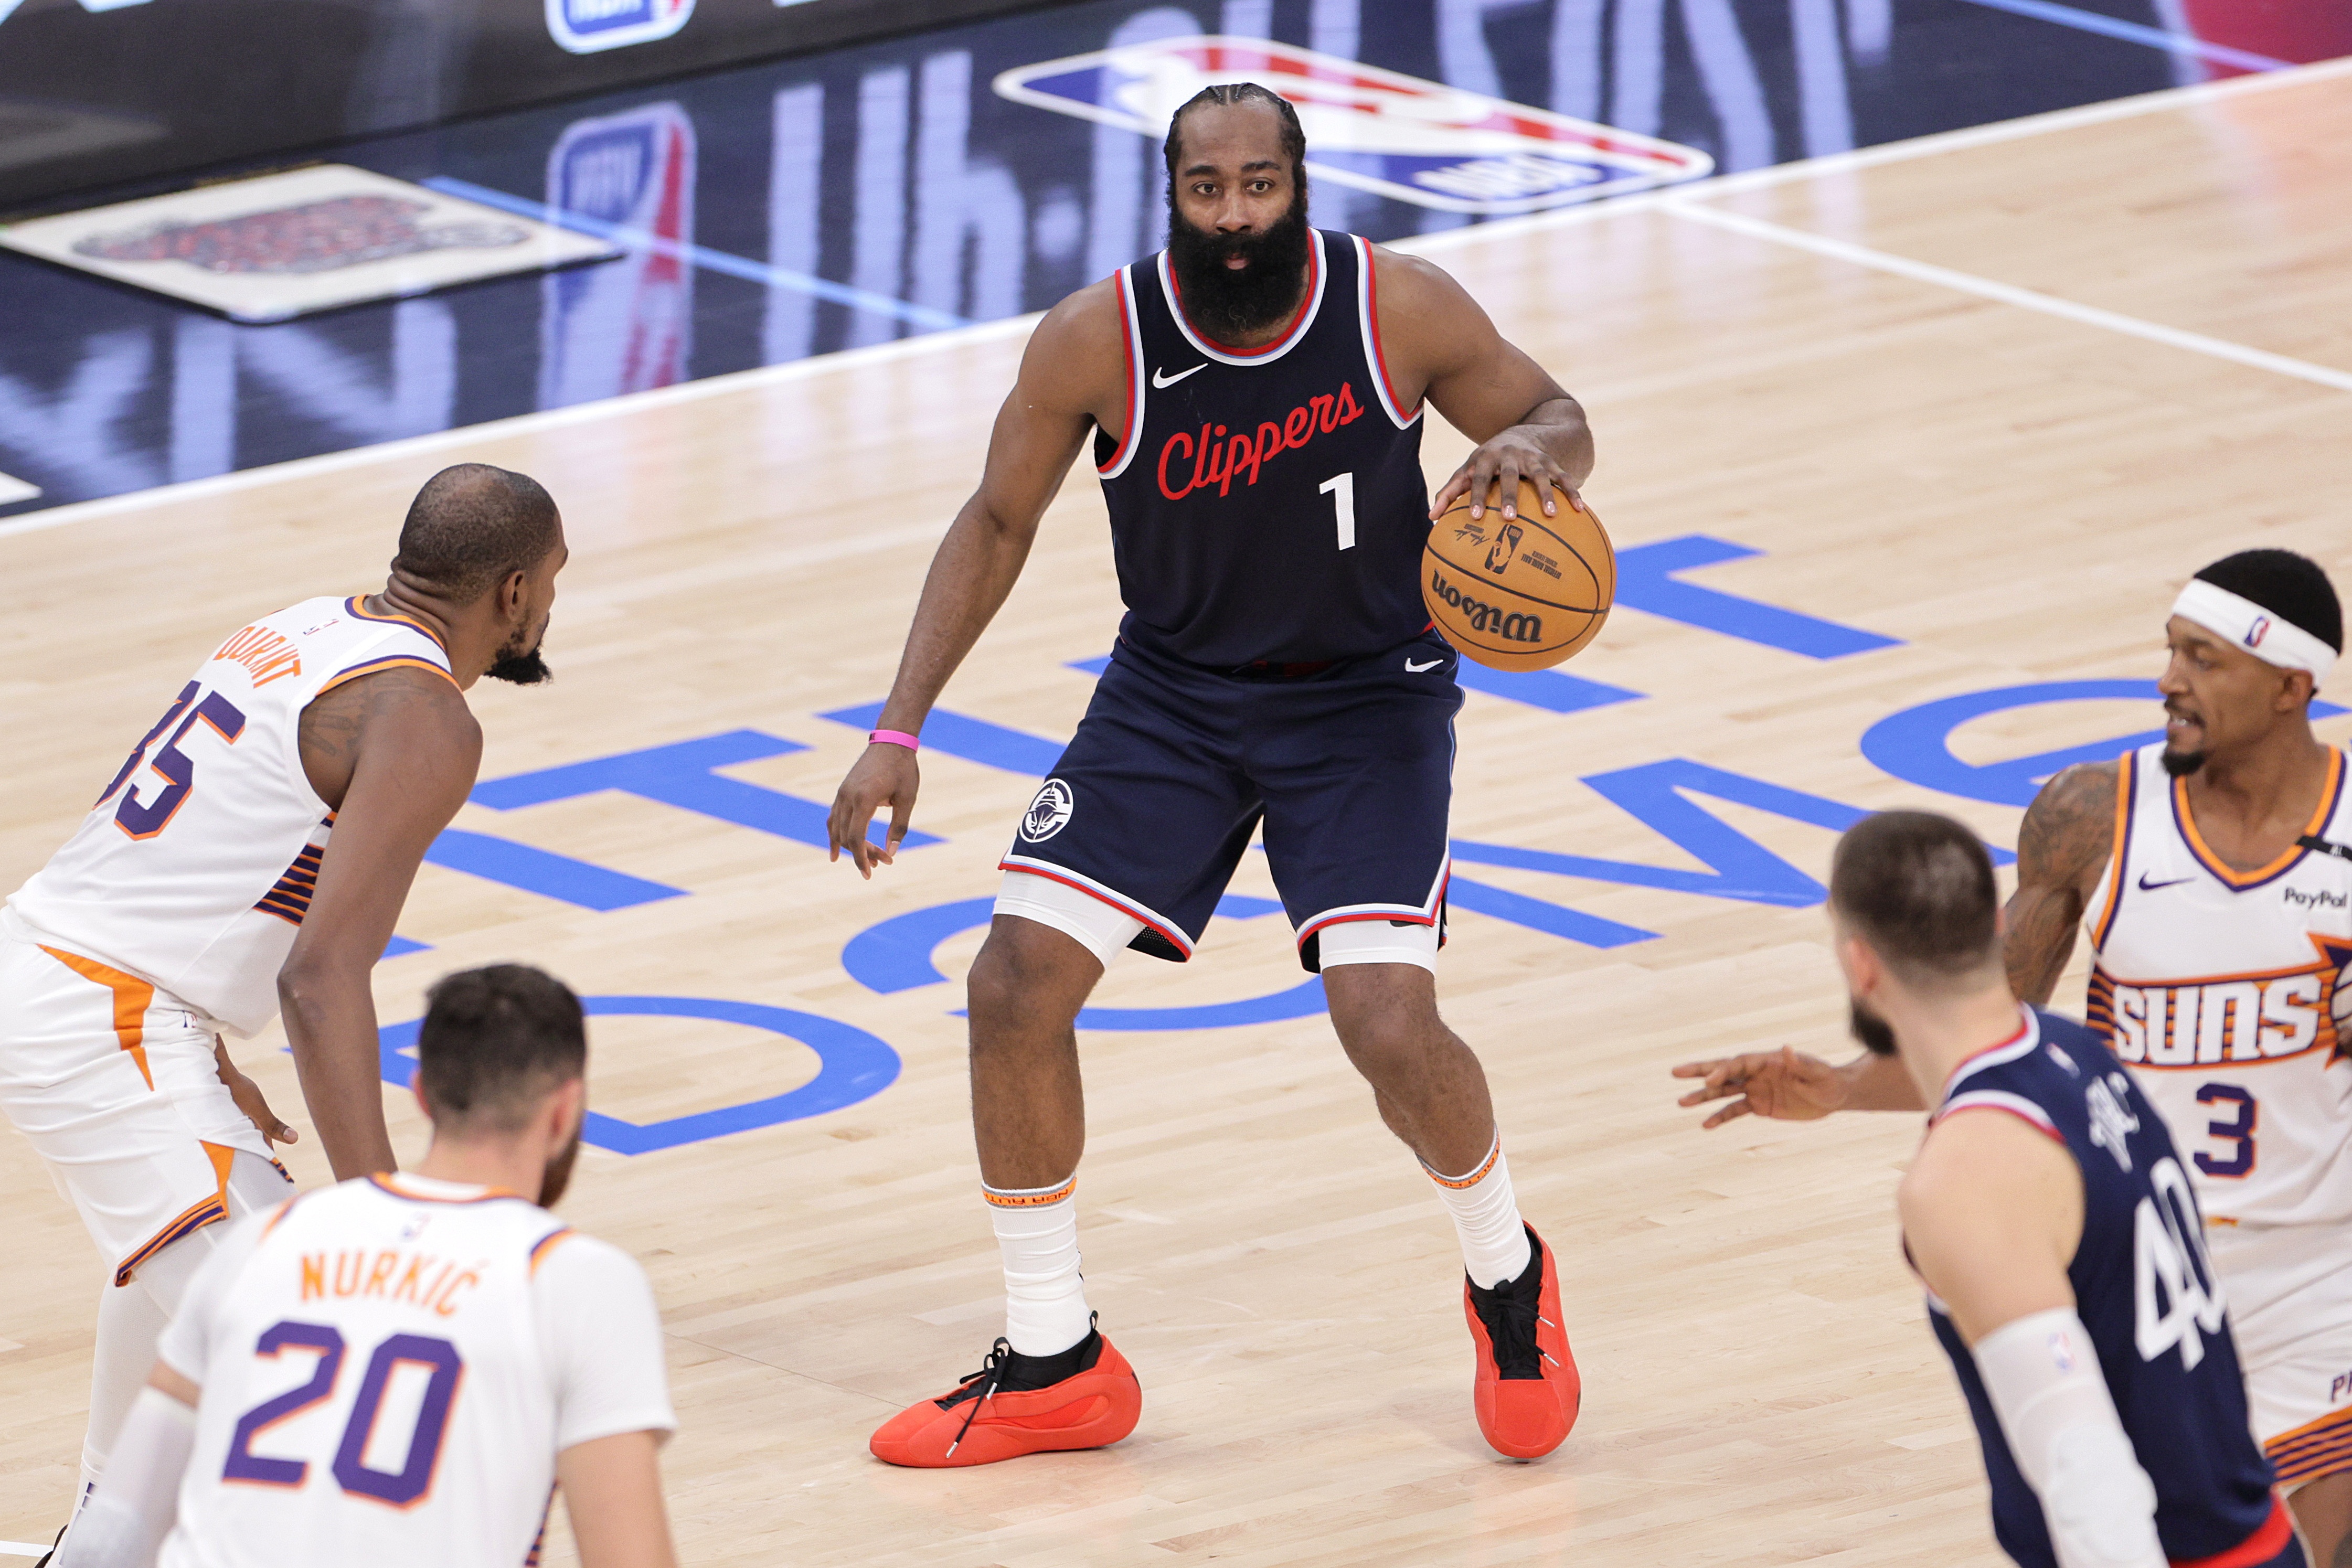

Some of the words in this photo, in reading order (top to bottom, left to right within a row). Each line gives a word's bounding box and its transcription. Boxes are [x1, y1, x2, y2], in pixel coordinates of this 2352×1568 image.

[1158, 381, 1365, 500] Clippers
[1319, 472, 1356, 551] 1
[1432, 568, 1542, 643] Wilson
[212, 626, 302, 689] DURANT
[2284, 887, 2348, 910] PayPal
[2113, 973, 2322, 1066] SUNS
[2194, 1082, 2260, 1180] 3
[1032, 1189, 1069, 1204] NBA
[300, 1249, 489, 1318] NURKIĆ
[2134, 1156, 2228, 1371] 40
[221, 1320, 467, 1511] 20
